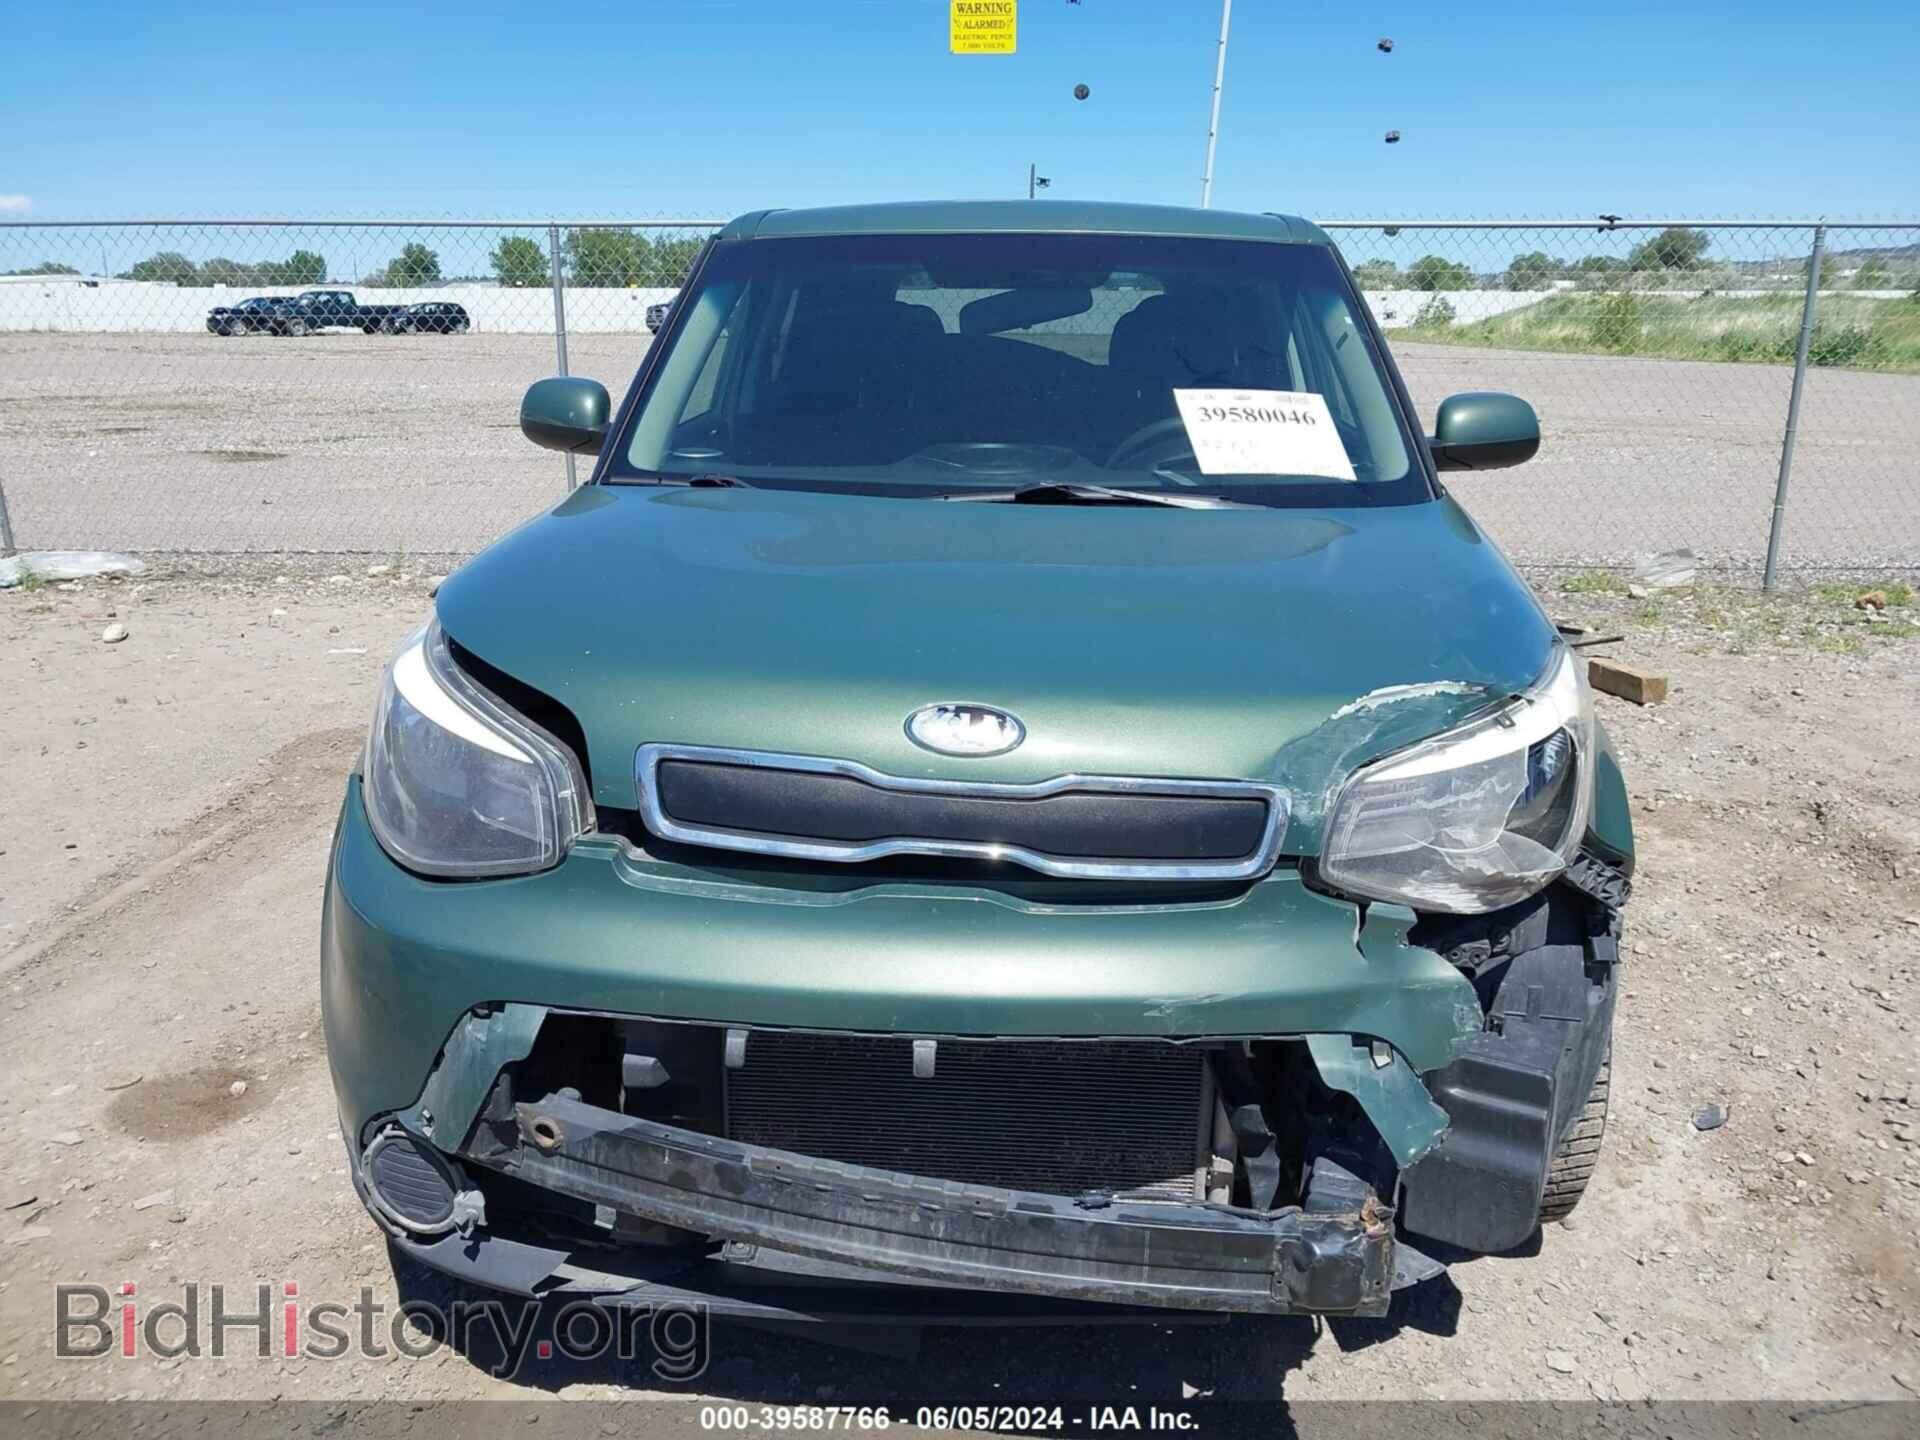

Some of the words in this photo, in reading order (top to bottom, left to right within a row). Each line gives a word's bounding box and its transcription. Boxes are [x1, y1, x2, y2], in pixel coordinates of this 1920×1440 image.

[957, 2, 1012, 14] WARNING
[964, 20, 1006, 30] ALARMED
[1198, 406, 1317, 427] 39580046
